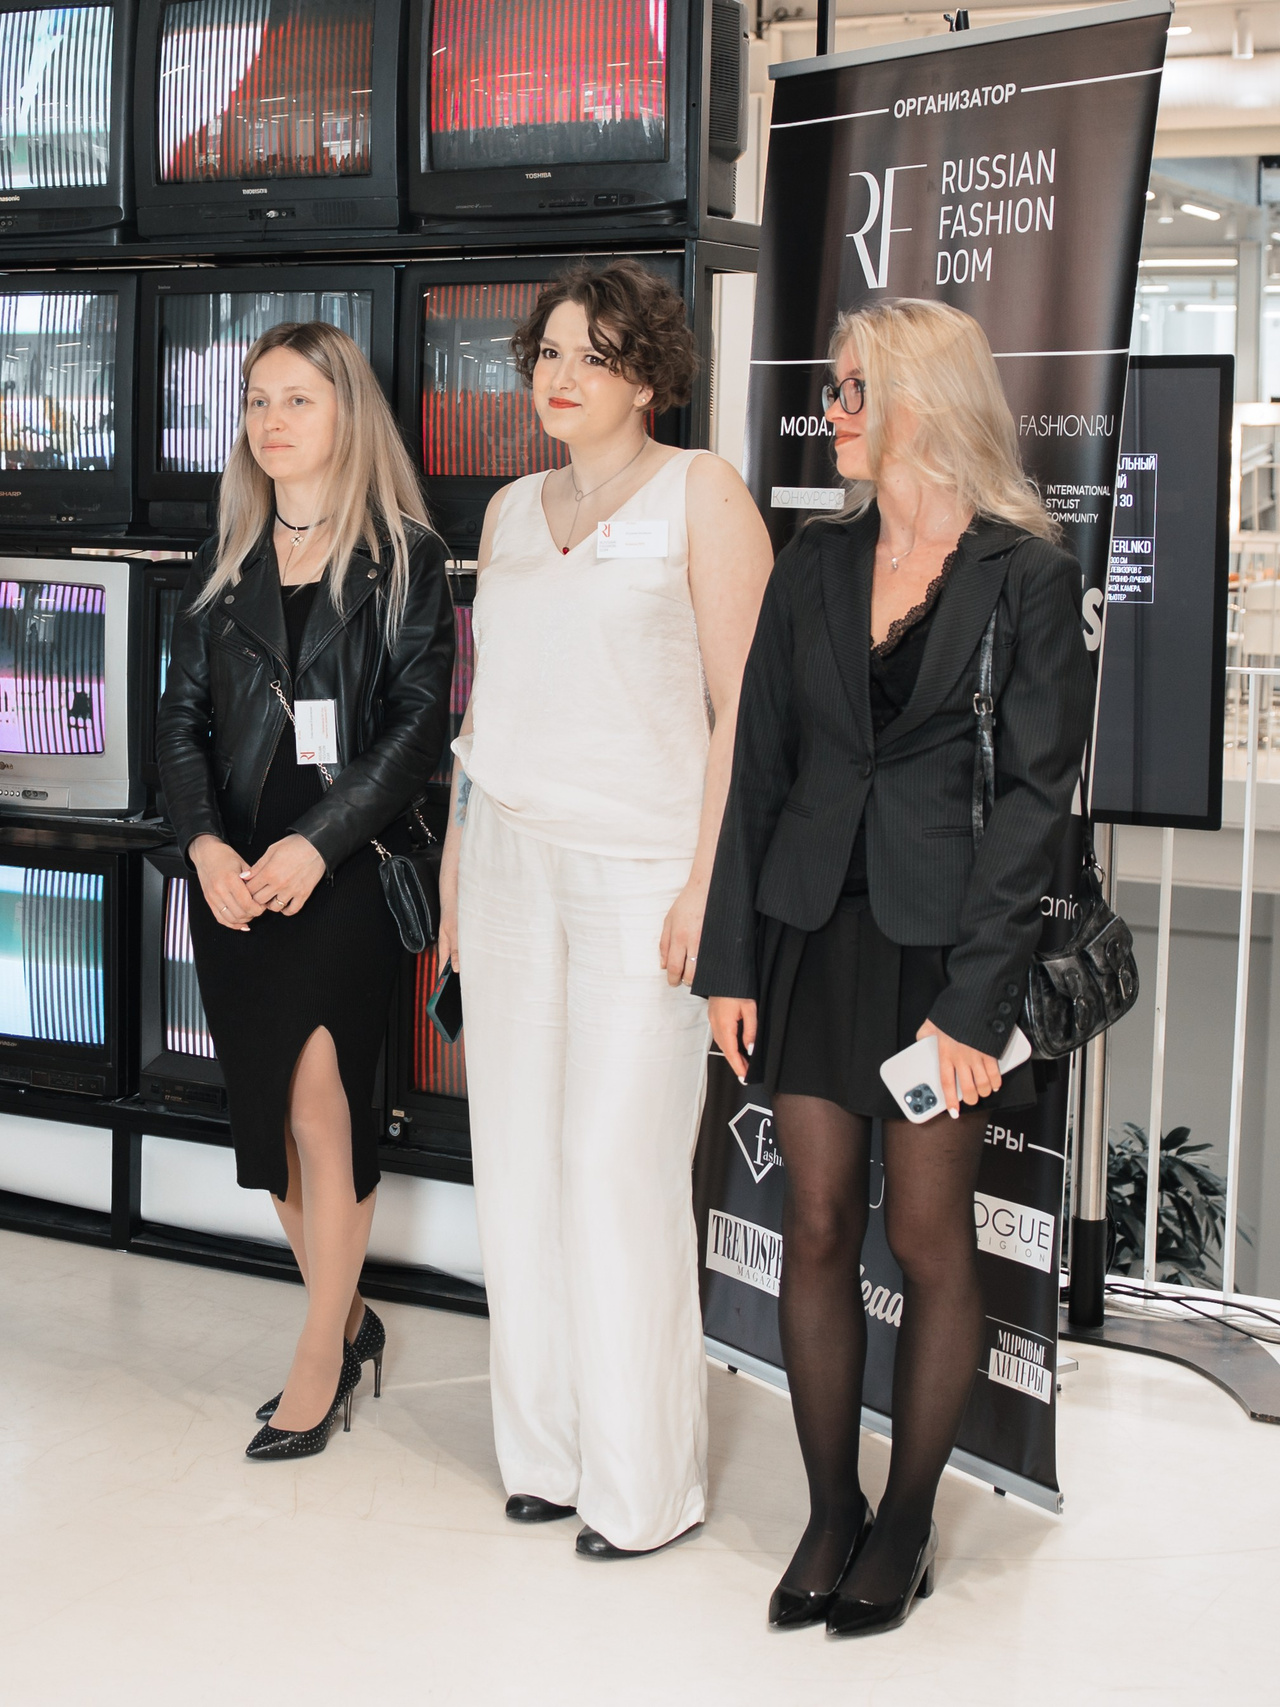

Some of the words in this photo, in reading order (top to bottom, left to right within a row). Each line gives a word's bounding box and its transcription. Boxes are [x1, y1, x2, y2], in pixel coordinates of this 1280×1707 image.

[893, 83, 1017, 119] ОРГАНИЗАТОР
[941, 148, 1056, 195] RUSSIAN
[938, 196, 1055, 240] FASHION
[936, 247, 993, 286] DOM
[1019, 414, 1114, 436] FASHION.RU
[1118, 455, 1156, 470] ЛЬНЫЙ
[1045, 498, 1081, 509] STYLIST
[1046, 484, 1111, 496] INTERNATIONAL
[736, 1265, 780, 1292] MAGAZI
[996, 1329, 1048, 1367] МИРОВЫЕ
[991, 1352, 1045, 1393] ЛИДЕРЫ
